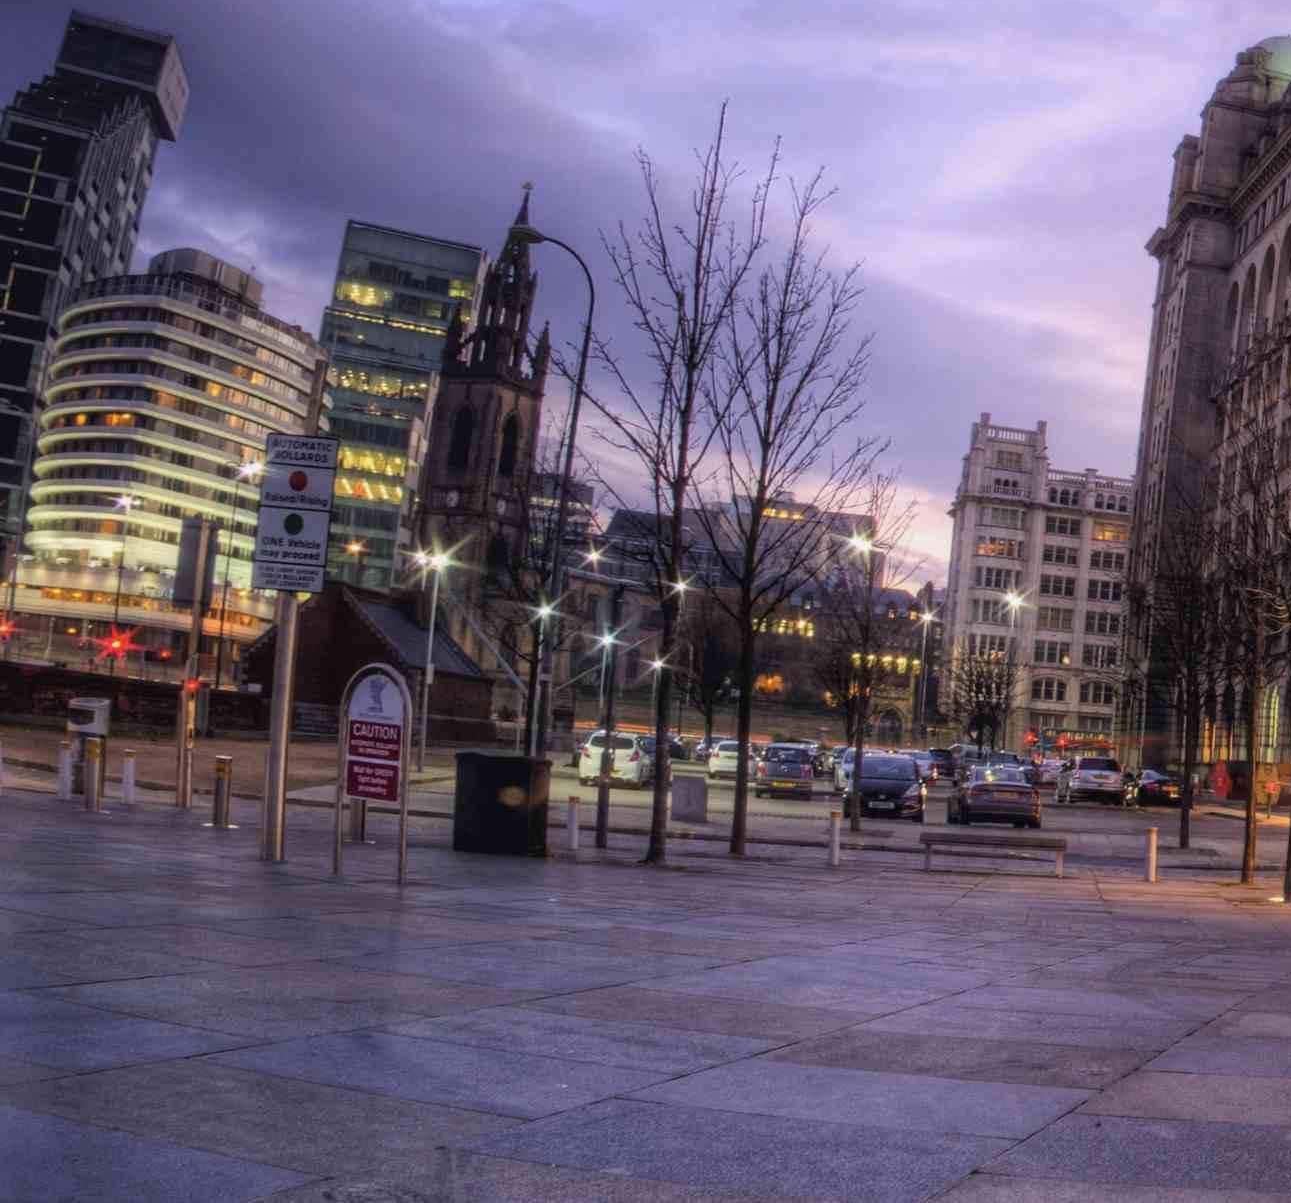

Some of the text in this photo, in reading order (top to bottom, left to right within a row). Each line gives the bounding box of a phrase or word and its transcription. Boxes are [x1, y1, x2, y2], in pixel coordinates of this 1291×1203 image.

[273, 438, 332, 452] AUTOMATIC
[274, 450, 328, 463] BOLLARDS
[353, 723, 398, 740] CAUTION
